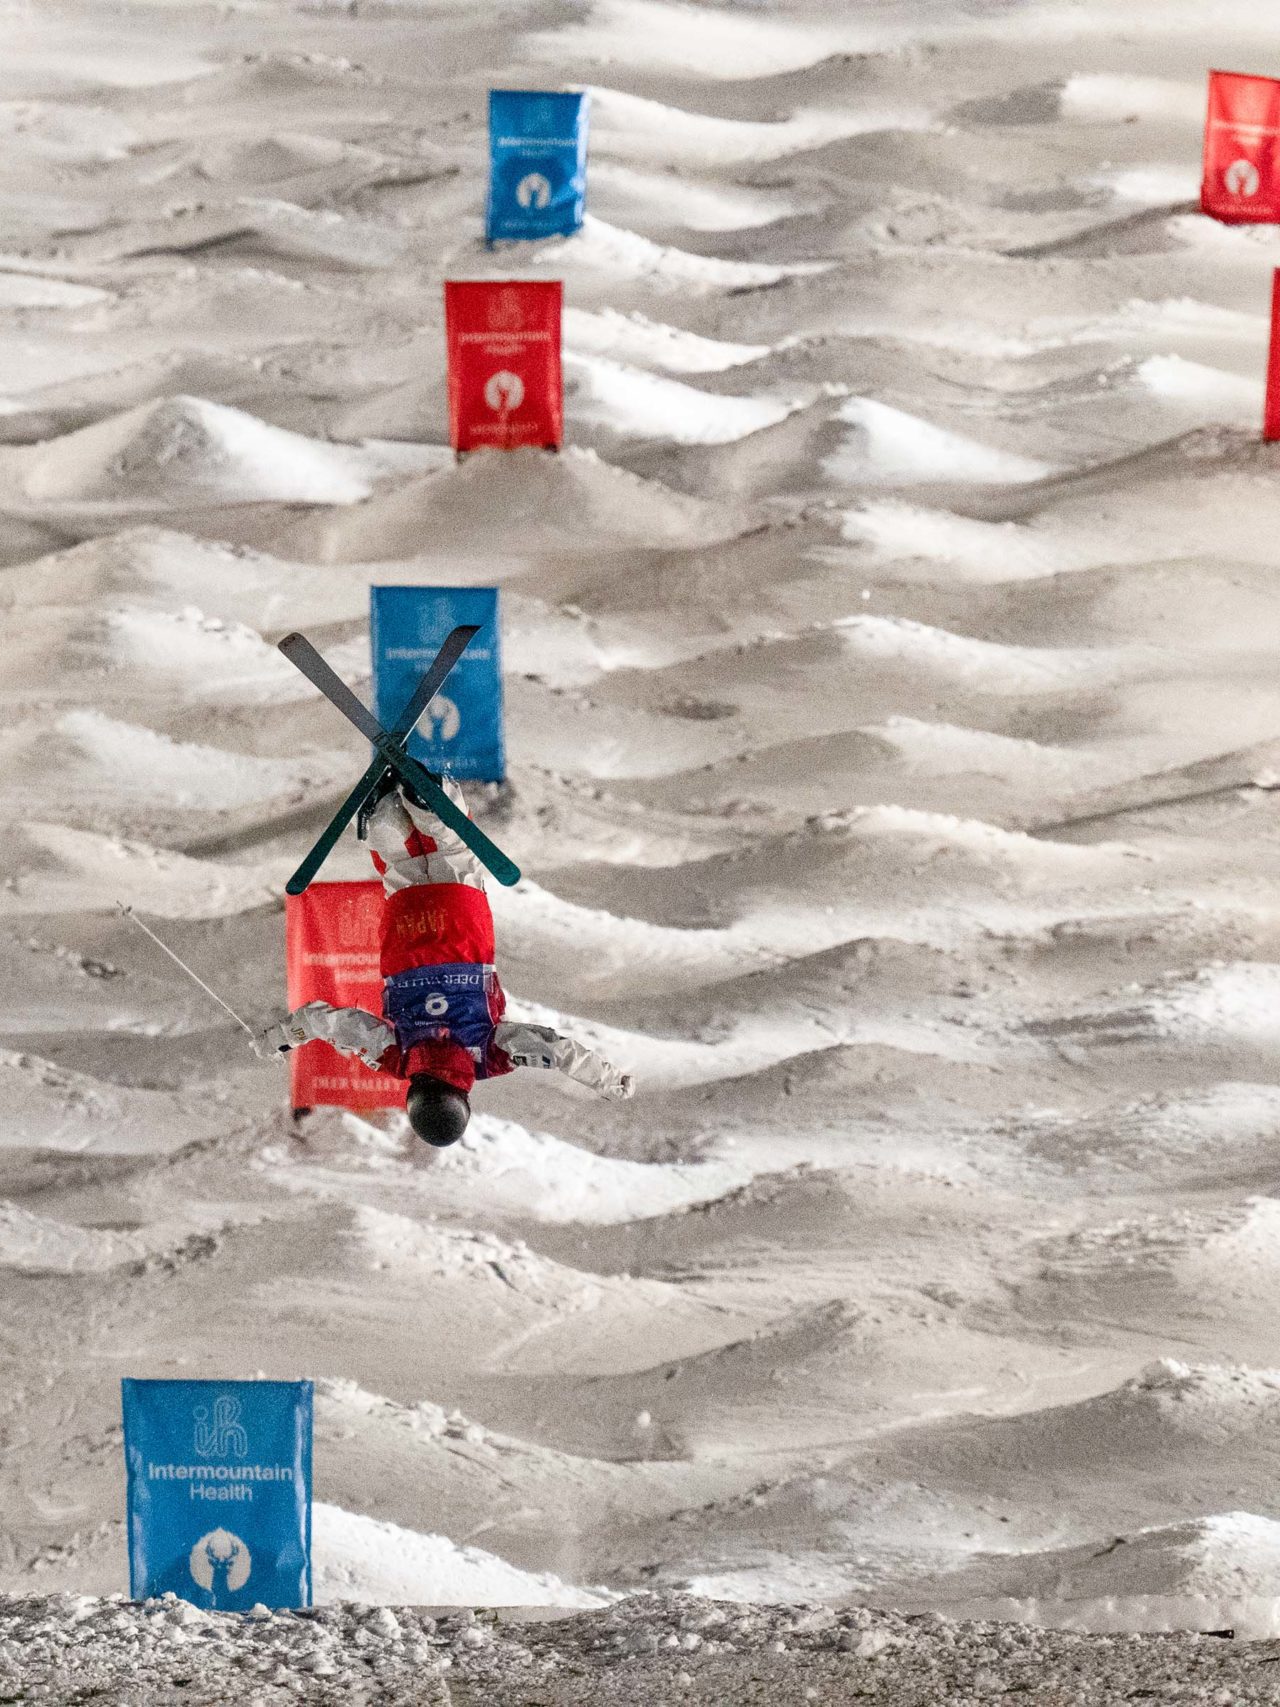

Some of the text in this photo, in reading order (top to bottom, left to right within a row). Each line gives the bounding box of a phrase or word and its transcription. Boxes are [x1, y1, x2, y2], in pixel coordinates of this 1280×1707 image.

[444, 973, 480, 985] DEER
[148, 1462, 294, 1482] Intermountain
[190, 1483, 254, 1501] Health
